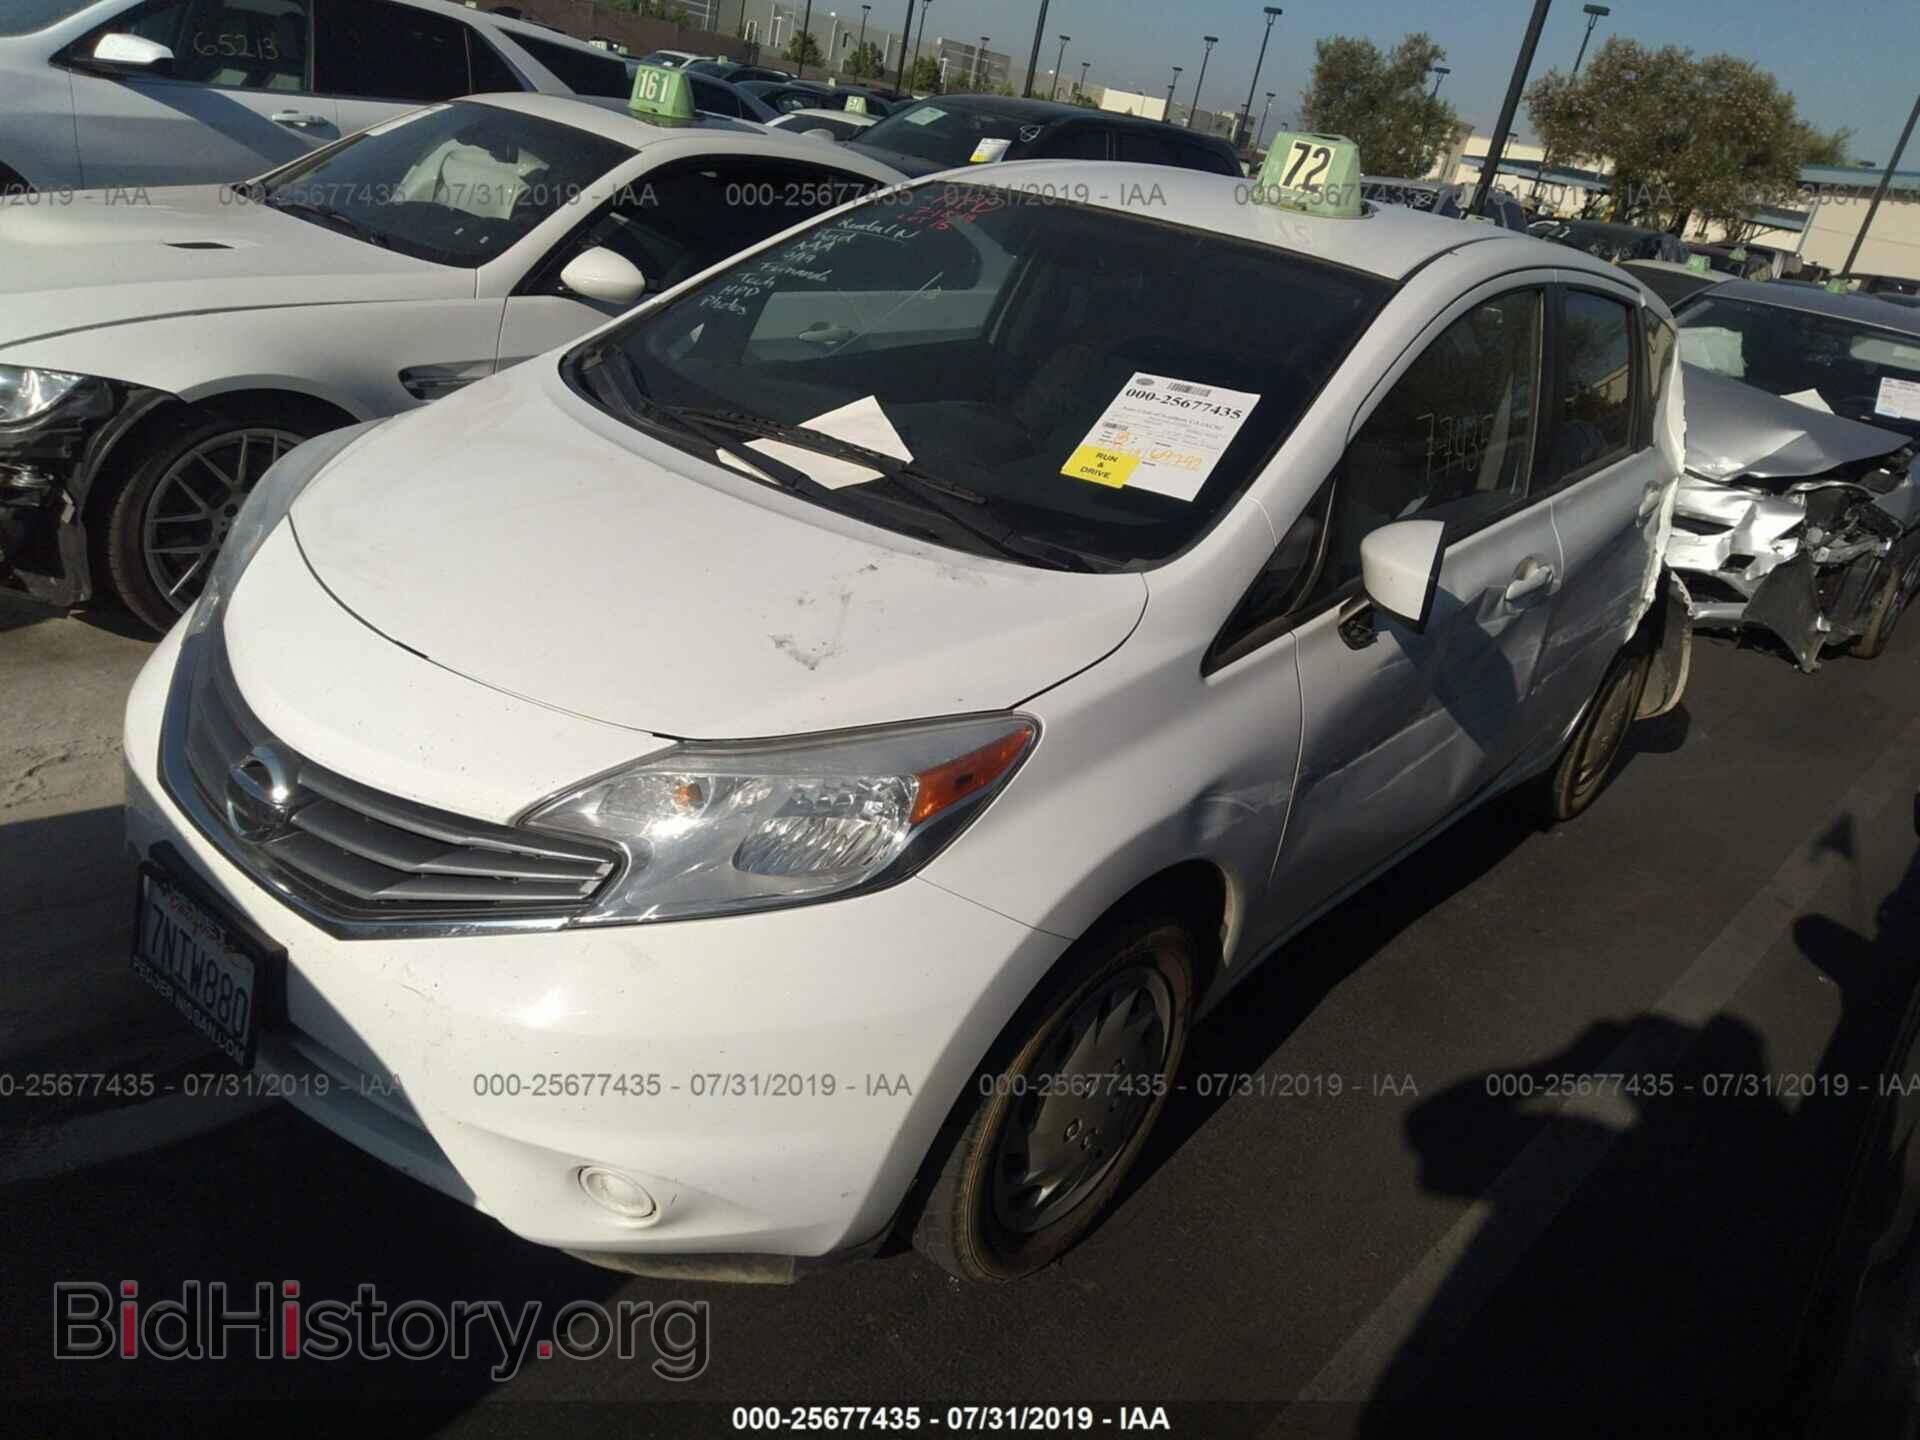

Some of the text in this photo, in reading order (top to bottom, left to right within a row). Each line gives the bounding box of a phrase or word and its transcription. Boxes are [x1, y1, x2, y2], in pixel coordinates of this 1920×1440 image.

[638, 70, 670, 103] 161
[1282, 142, 1332, 193] 72
[1125, 388, 1243, 420] 000-25677435
[1080, 466, 1112, 480] DRIVE
[1095, 452, 1119, 463] RUN
[152, 903, 249, 1038] 7NIW880
